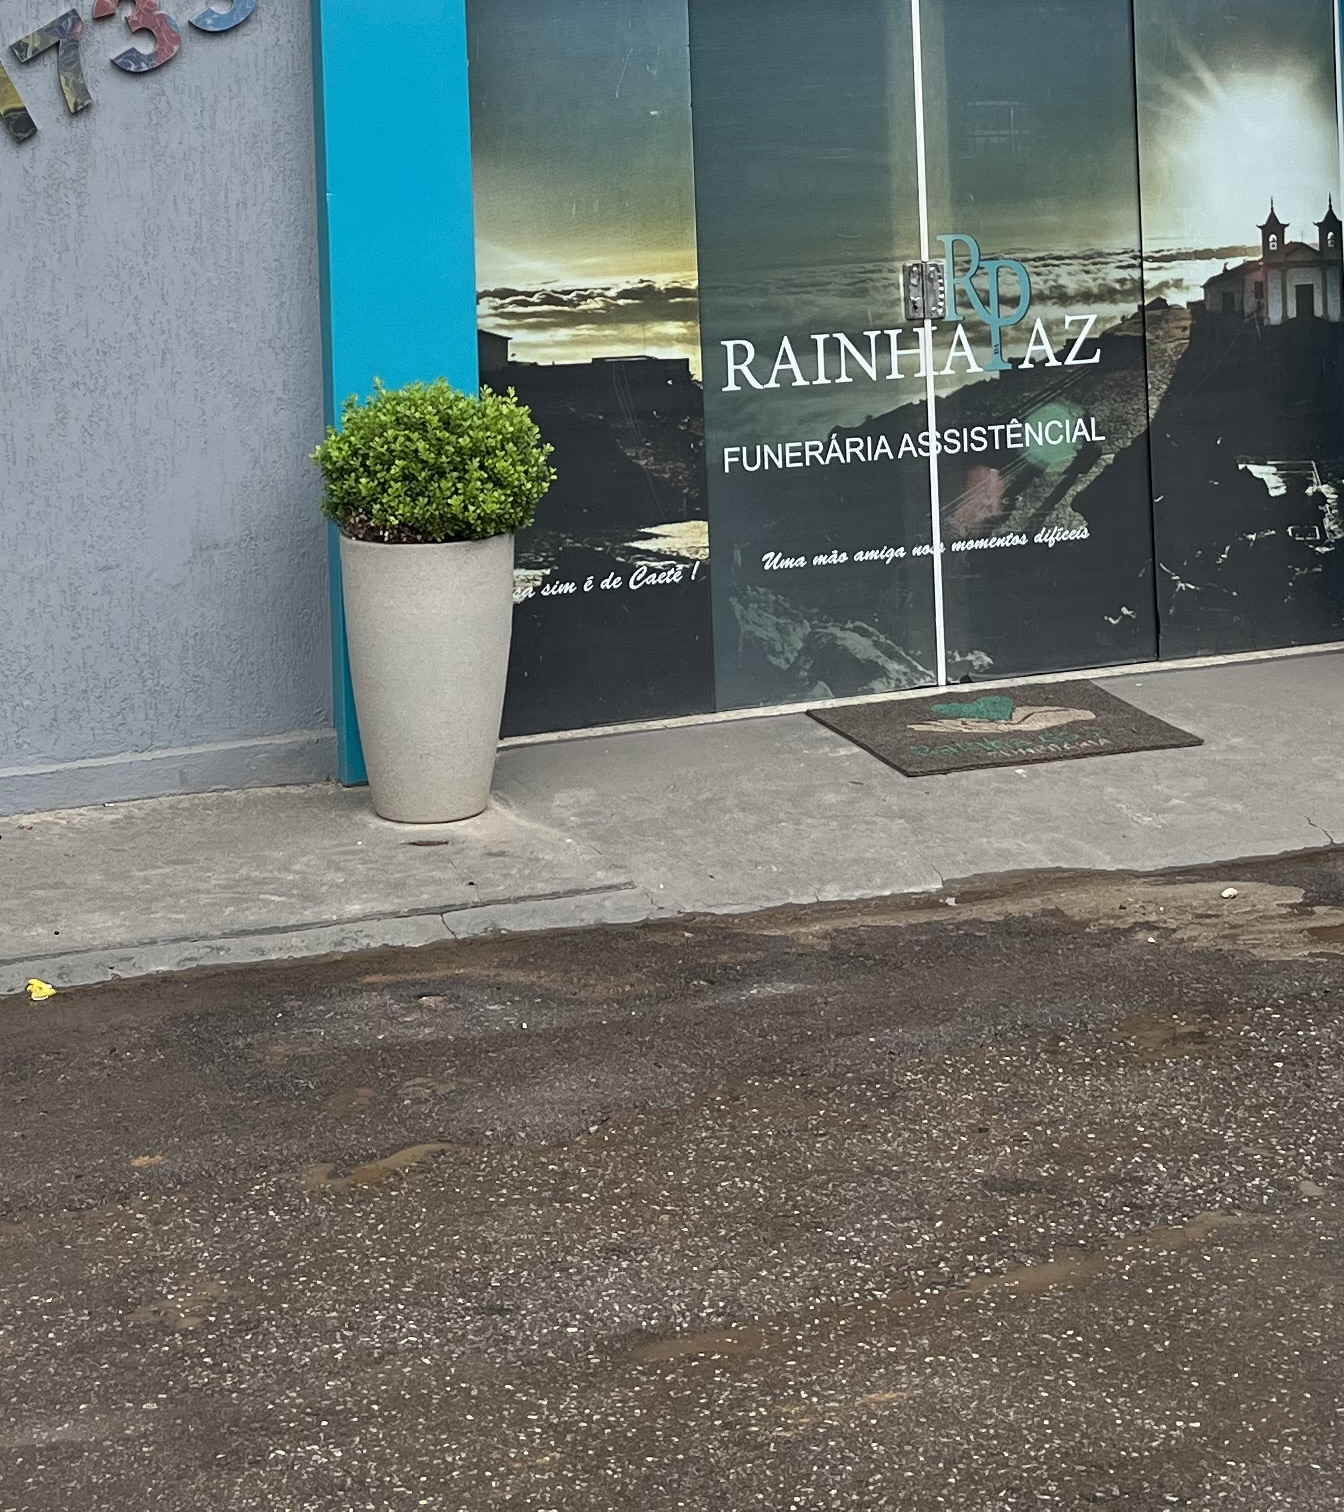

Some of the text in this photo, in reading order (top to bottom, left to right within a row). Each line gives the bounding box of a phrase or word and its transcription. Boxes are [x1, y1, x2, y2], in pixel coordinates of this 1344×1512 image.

[721, 323, 984, 393] RAINHA
[723, 417, 1105, 474] FUNERÁRIA ASSISTÊNCIAL
[761, 551, 807, 571] Uma
[812, 549, 848, 566] mão
[853, 545, 906, 565] amiga
[951, 532, 1028, 552] momentos
[1033, 525, 1090, 548] difíceis
[541, 580, 577, 597] sim
[583, 575, 594, 592] é
[600, 571, 623, 589] de
[628, 564, 683, 590] Caeté
